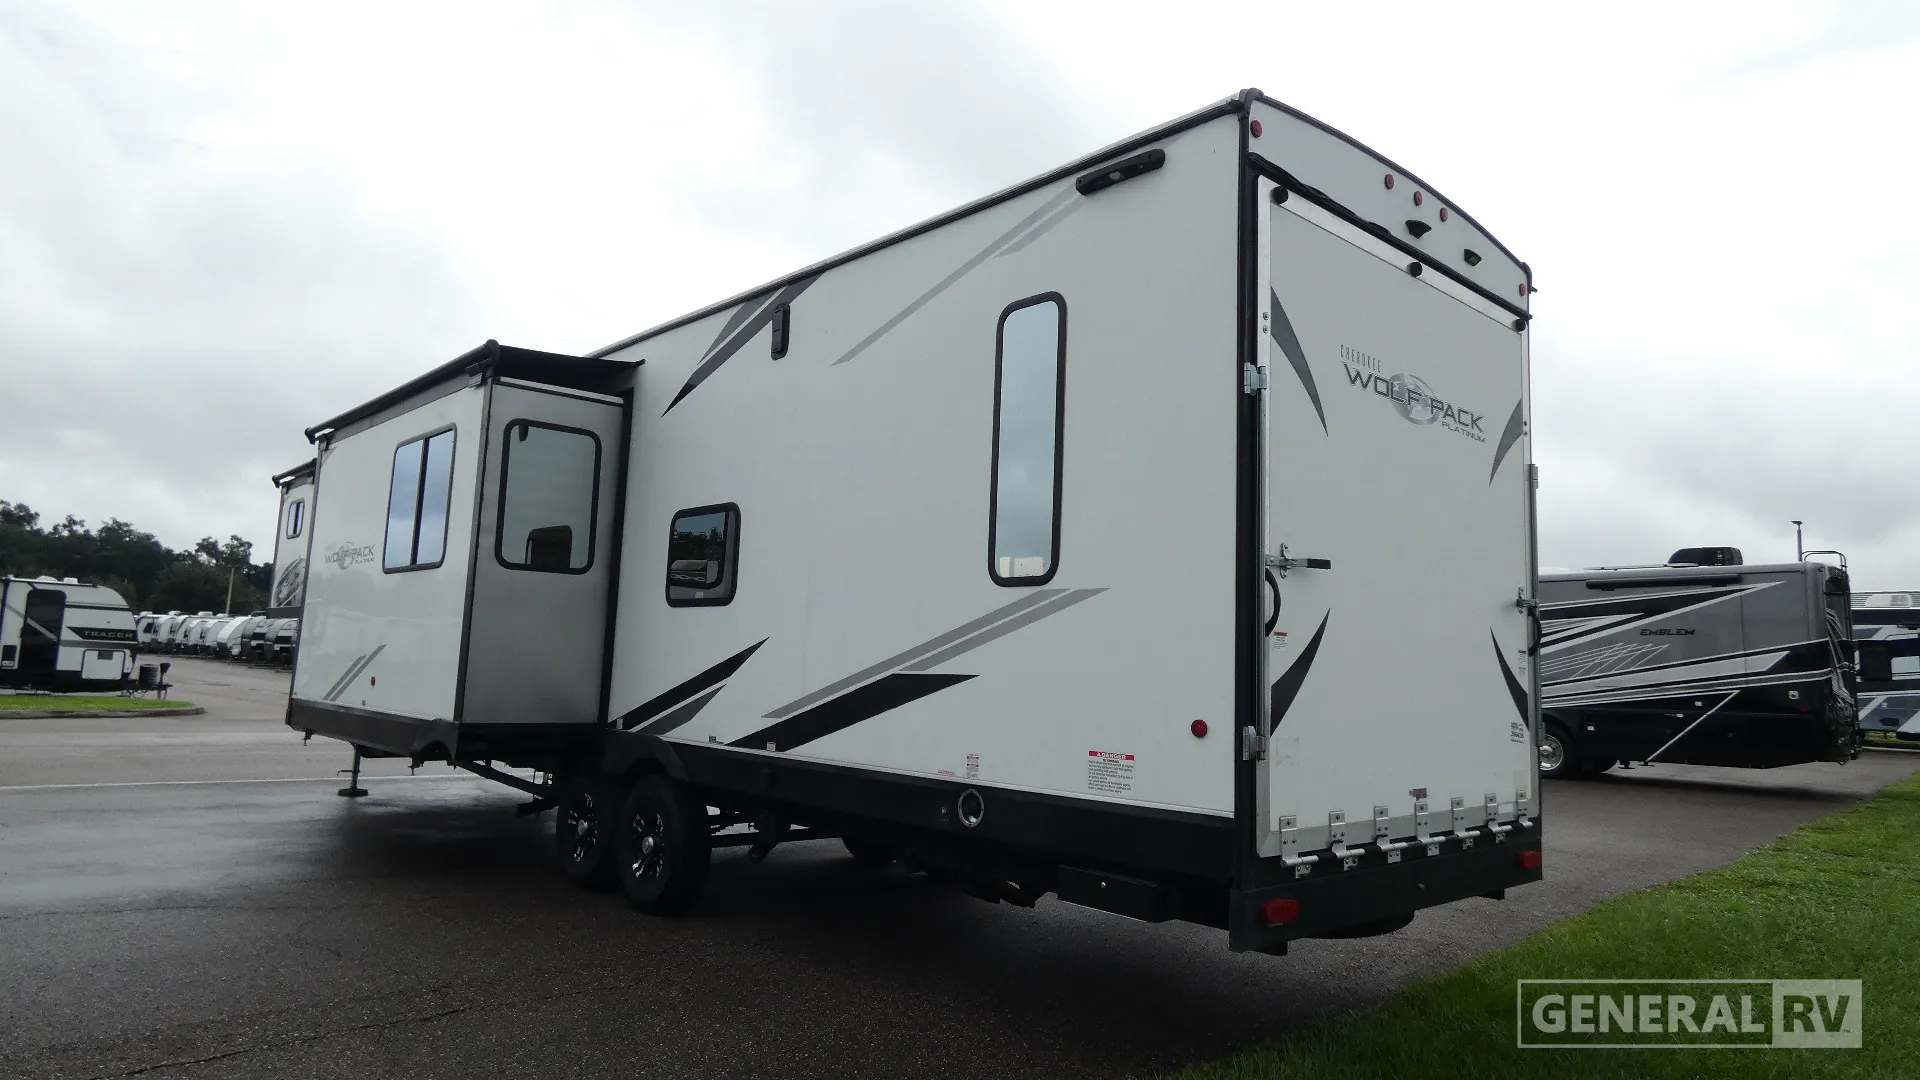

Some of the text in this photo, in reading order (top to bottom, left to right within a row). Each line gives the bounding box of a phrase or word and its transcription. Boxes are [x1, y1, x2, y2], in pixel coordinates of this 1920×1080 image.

[1340, 344, 1381, 373] CHEROKEE
[1342, 362, 1484, 433] WOLF PACK
[1441, 420, 1486, 443] PLATINUM
[83, 630, 133, 639] TRACER
[1640, 628, 1696, 636] EMBLEM
